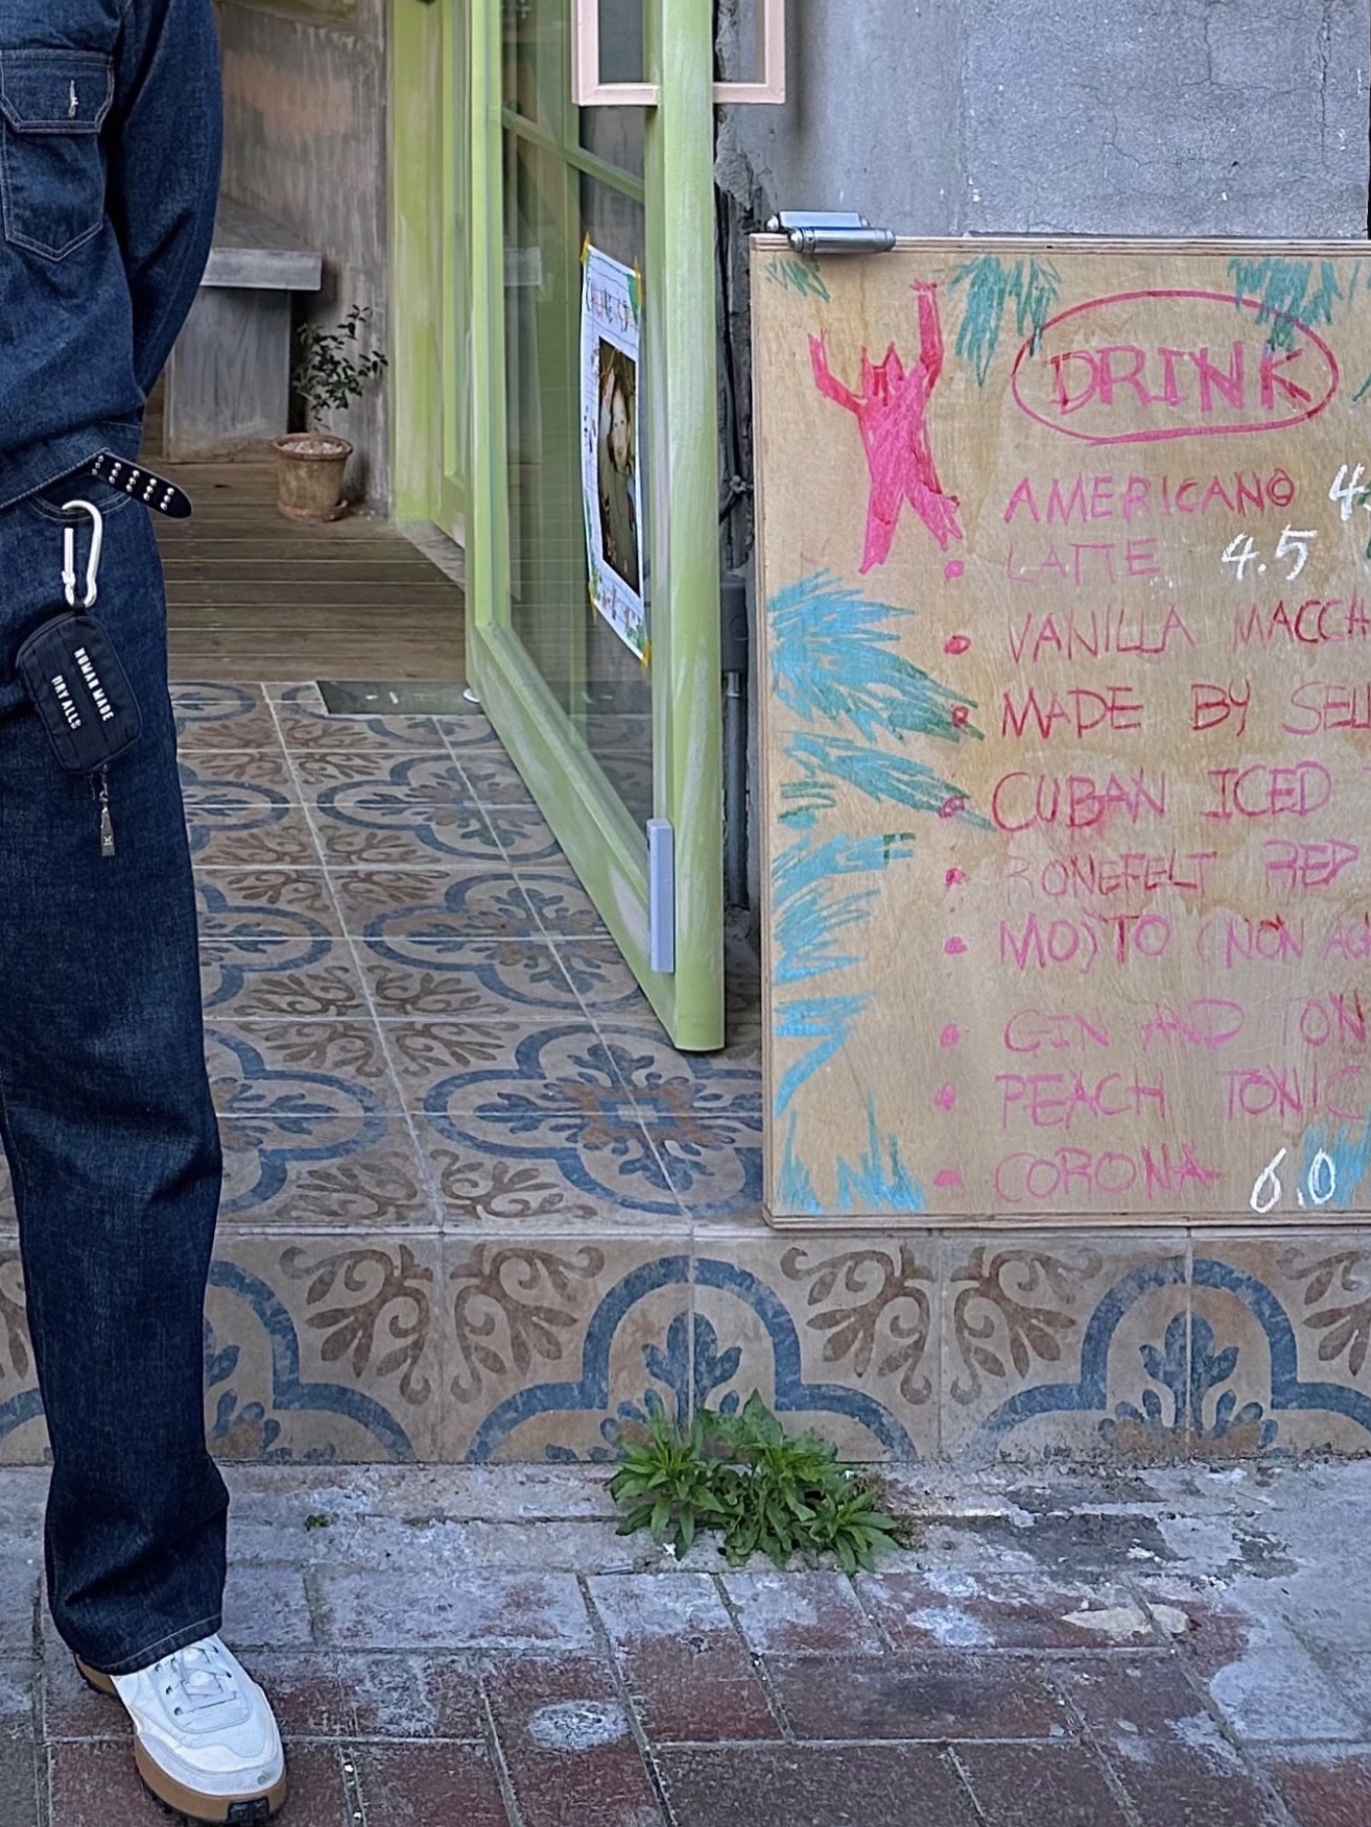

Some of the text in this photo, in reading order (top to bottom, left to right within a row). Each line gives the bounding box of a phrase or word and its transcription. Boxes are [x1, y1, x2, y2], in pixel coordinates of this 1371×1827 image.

[1049, 338, 1313, 416] DRINK
[1001, 467, 1295, 526] AMERICANO
[1005, 523, 1319, 586] LATTE 4.5
[1008, 602, 1197, 665] VANILLA
[60, 699, 82, 730] ALLS
[73, 646, 115, 722] HUMAN MADE
[1001, 678, 1251, 740] MADE BY
[992, 760, 1333, 834] CUBAN ICED
[1263, 837, 1360, 890] RED
[1003, 1006, 1110, 1057] GIN
[994, 1061, 1367, 1130] PEACH TONIC
[994, 1140, 1336, 1214] CORONA 6.0
